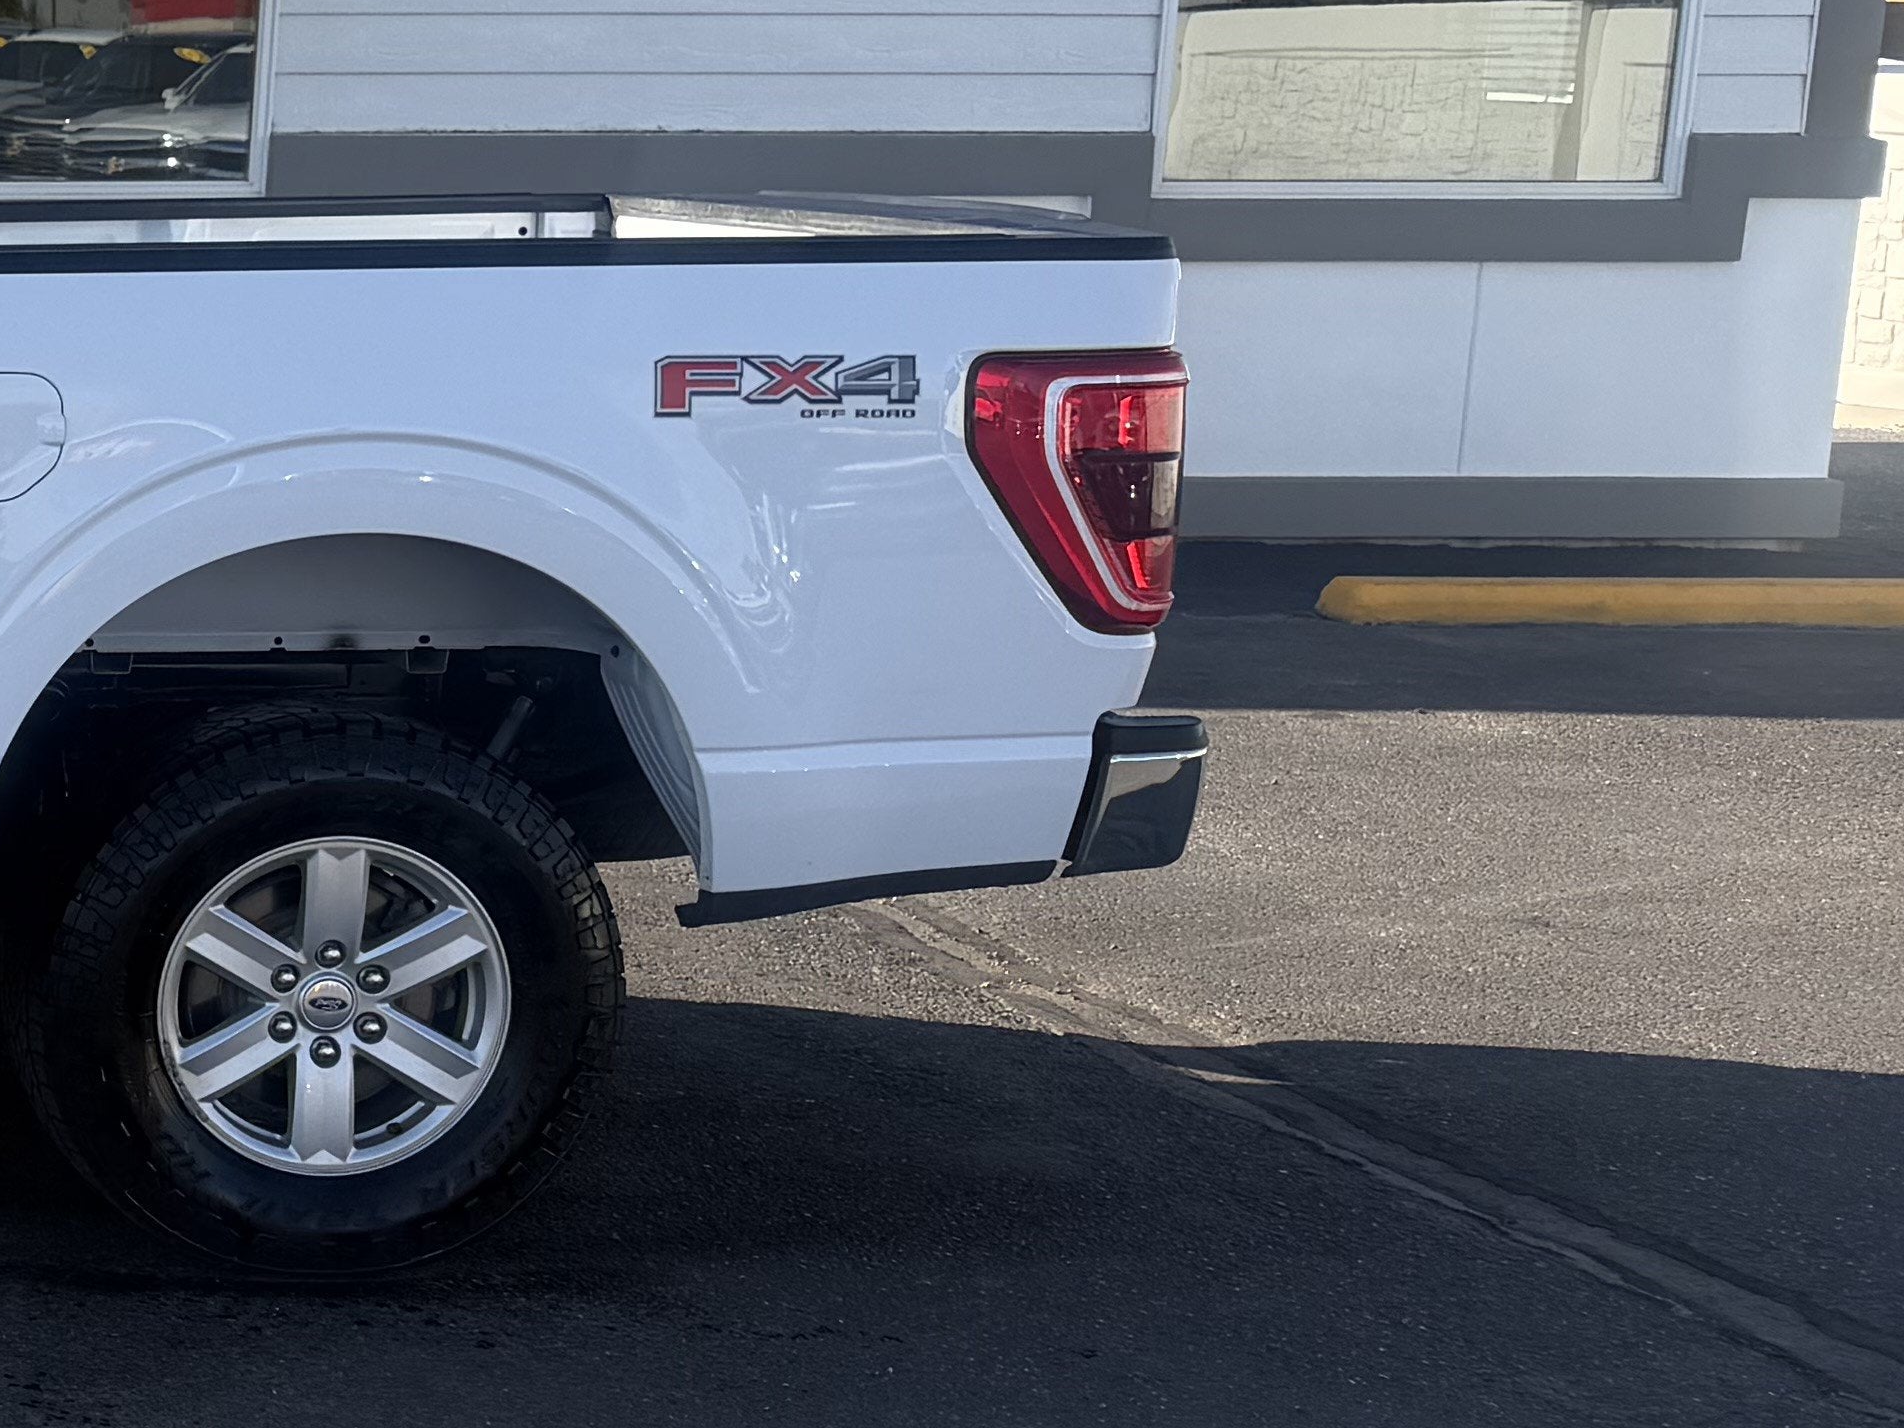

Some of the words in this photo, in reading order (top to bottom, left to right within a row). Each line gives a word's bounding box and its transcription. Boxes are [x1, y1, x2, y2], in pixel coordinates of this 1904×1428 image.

[653, 354, 920, 418] FX4
[799, 408, 846, 419] OFF
[854, 408, 916, 419] ROAD
